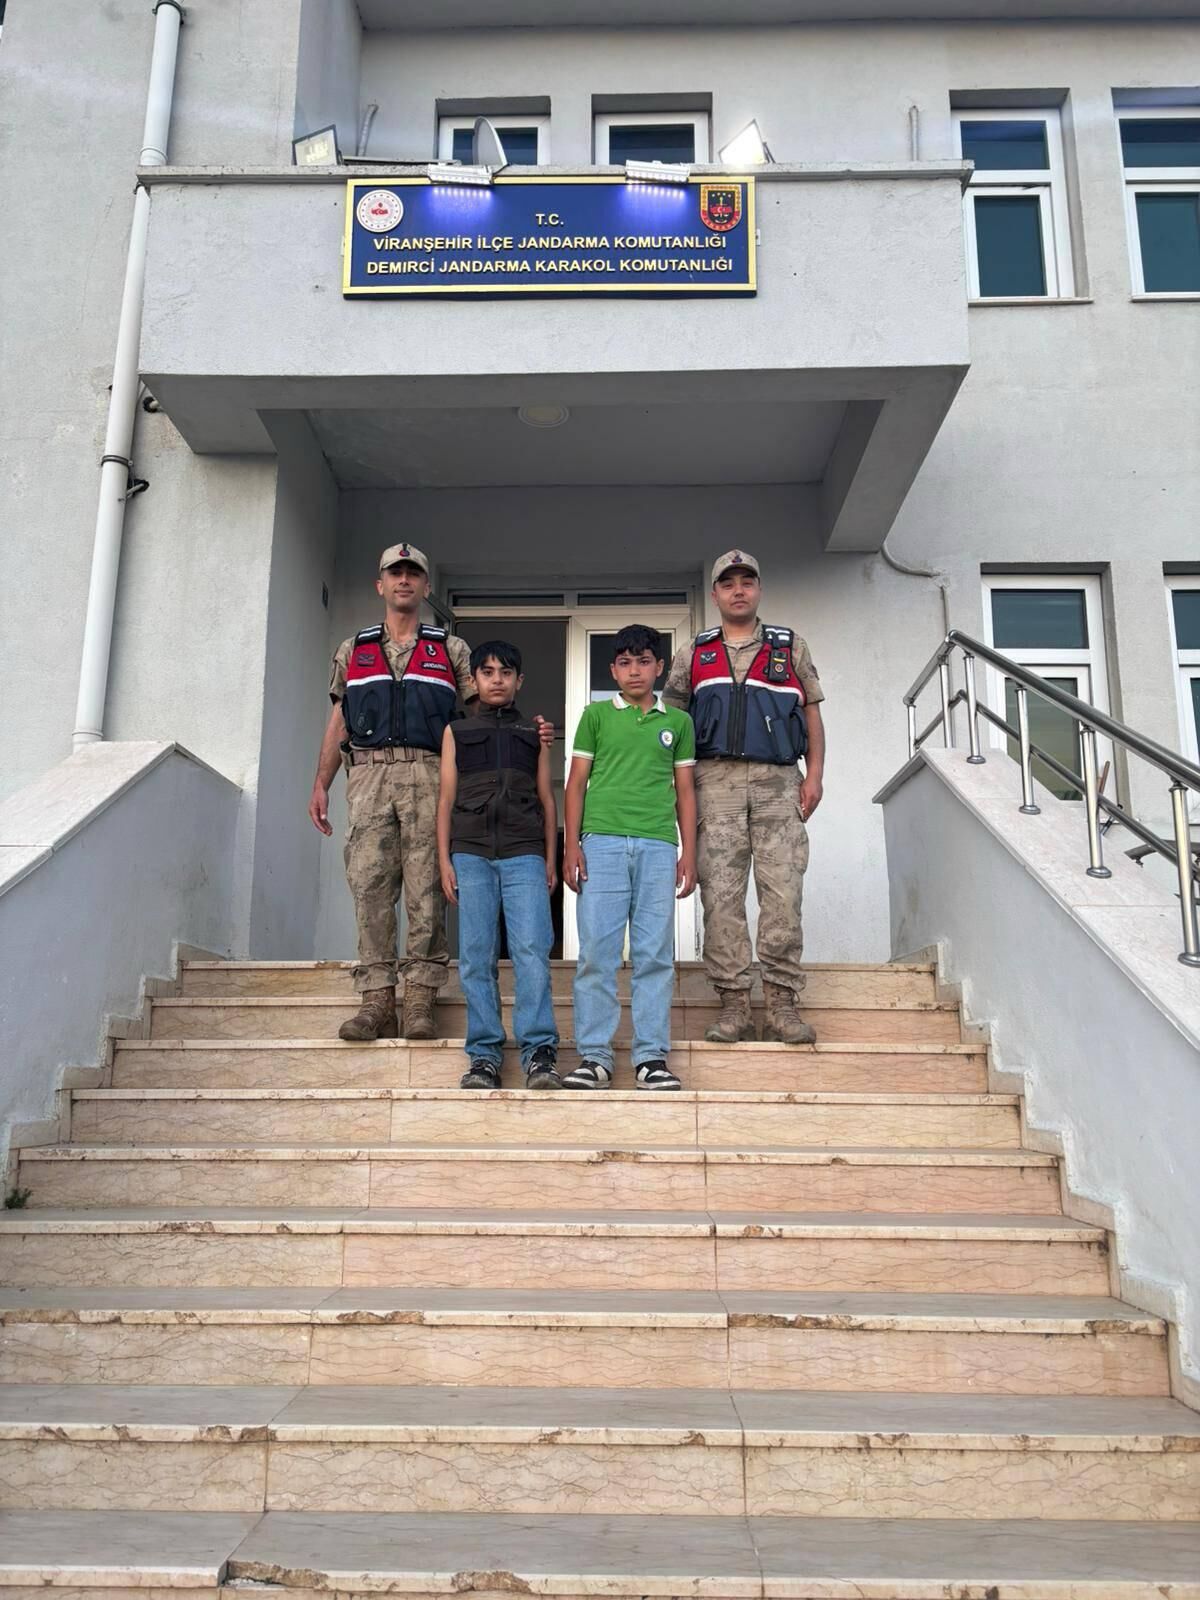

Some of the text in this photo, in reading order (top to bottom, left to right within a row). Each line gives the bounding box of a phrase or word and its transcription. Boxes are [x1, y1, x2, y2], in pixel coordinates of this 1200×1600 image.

[535, 213, 564, 225] T.C.
[373, 233, 727, 253] VİRANŞEHİR İLÇE JANDARMA KOMUTANLIĞI
[439, 260, 531, 274] JANDARMA
[535, 259, 615, 273] KARAKOL
[619, 256, 733, 272] KOMUTANLIĞI
